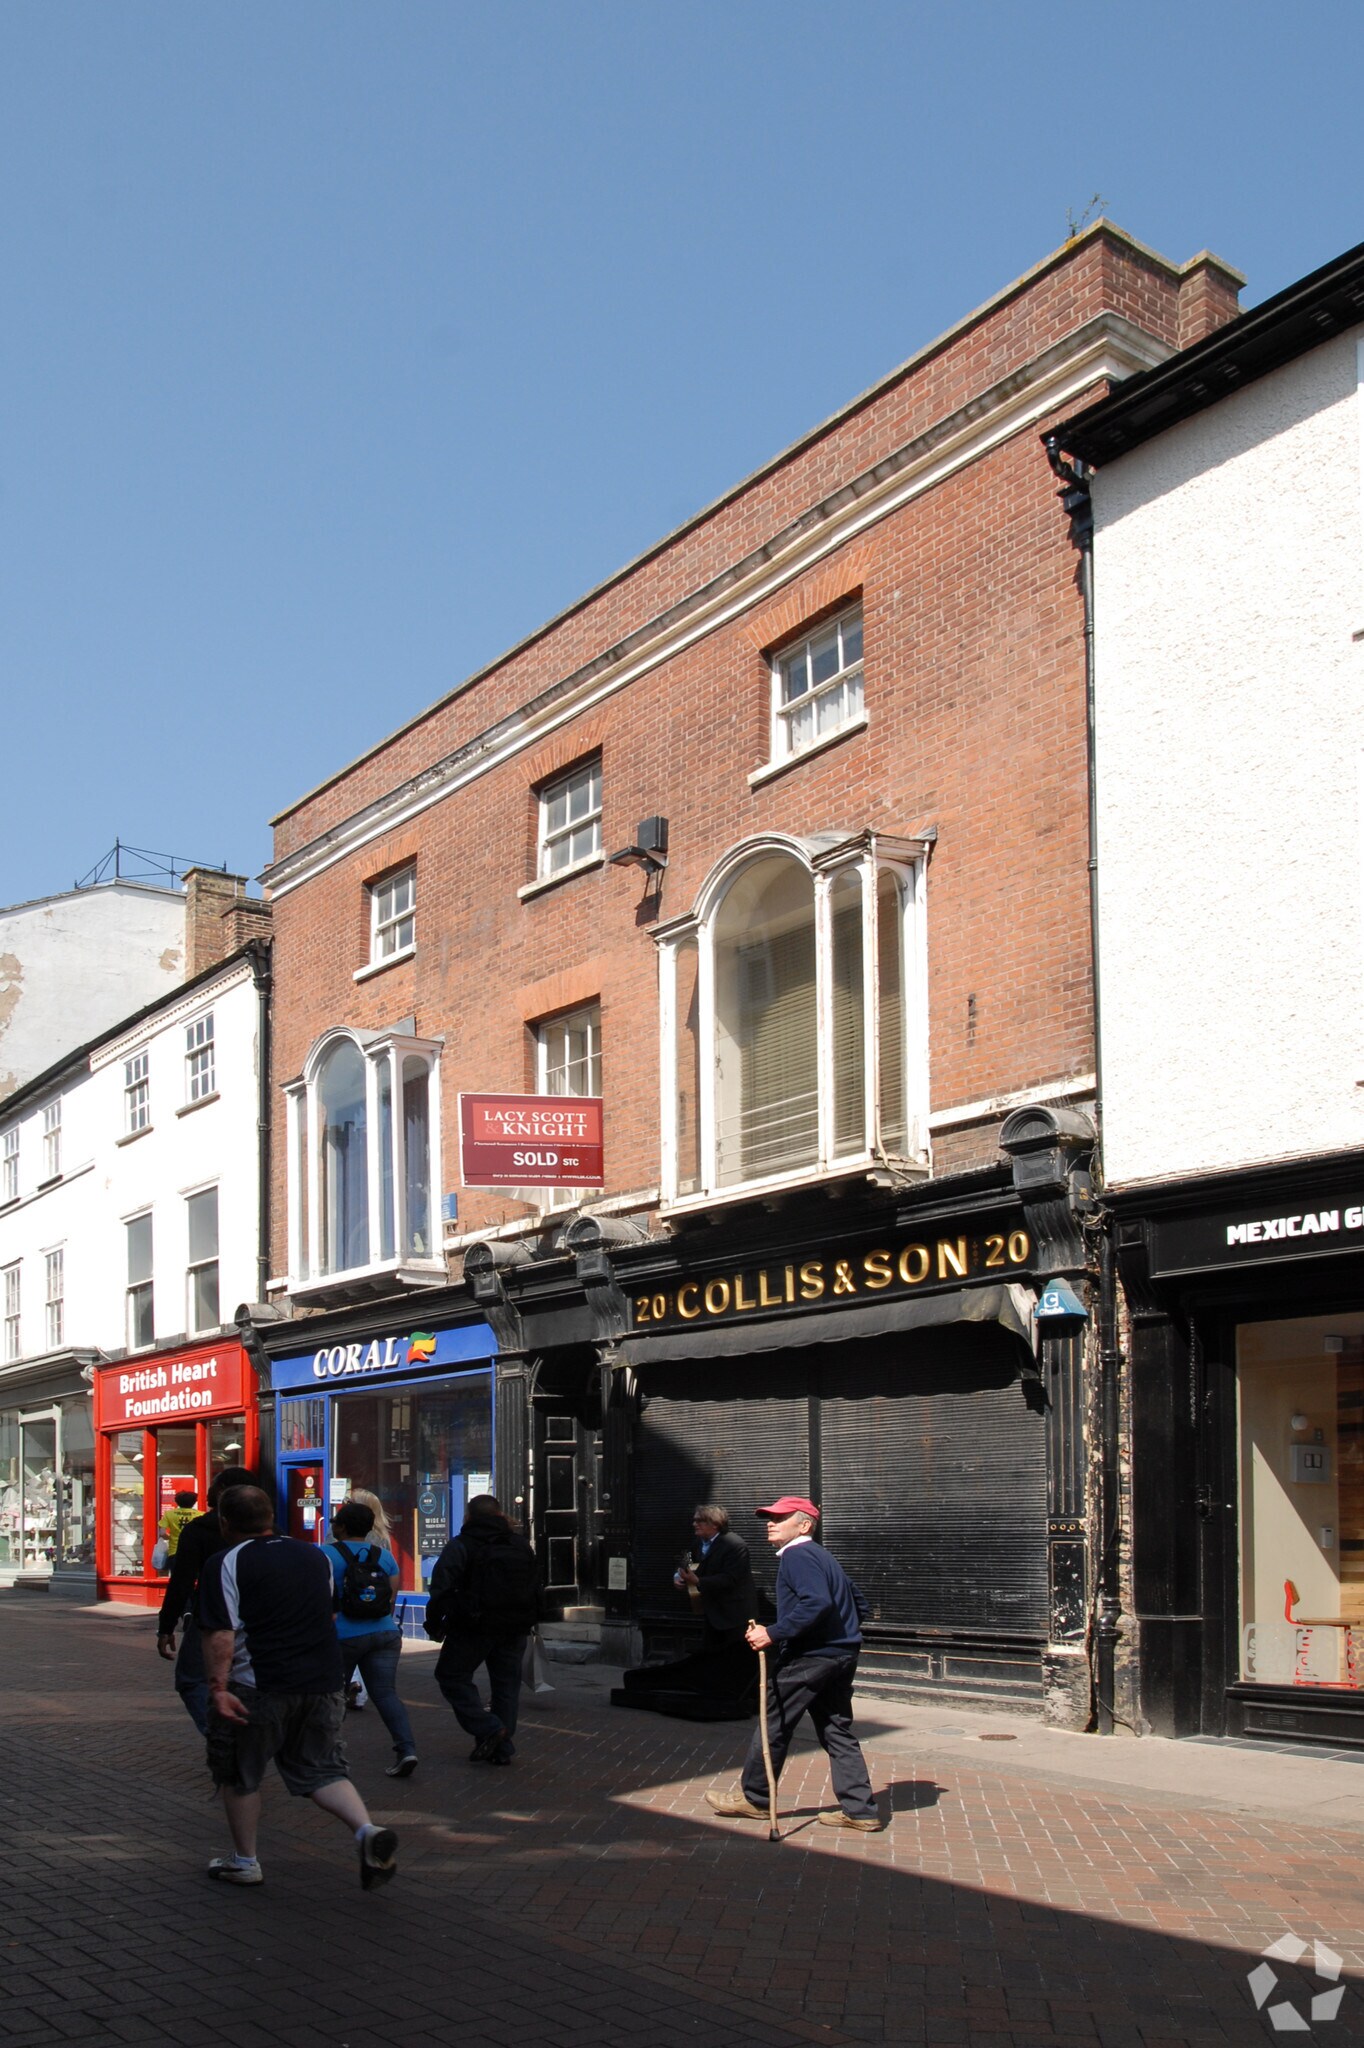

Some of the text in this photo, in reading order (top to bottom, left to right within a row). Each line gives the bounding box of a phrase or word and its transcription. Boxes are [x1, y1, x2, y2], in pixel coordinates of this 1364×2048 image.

[484, 1110, 587, 1124] LACY SCOTT
[502, 1122, 588, 1137] KNIGHT
[513, 1151, 580, 1167] SOLD STC
[1227, 1205, 1364, 1246] MEXICAN G
[636, 1230, 1029, 1322] 20 COLLIS & SON 20
[312, 1337, 400, 1378] CORAL
[120, 1357, 217, 1394] British Heart
[125, 1387, 213, 1418] Foundation
